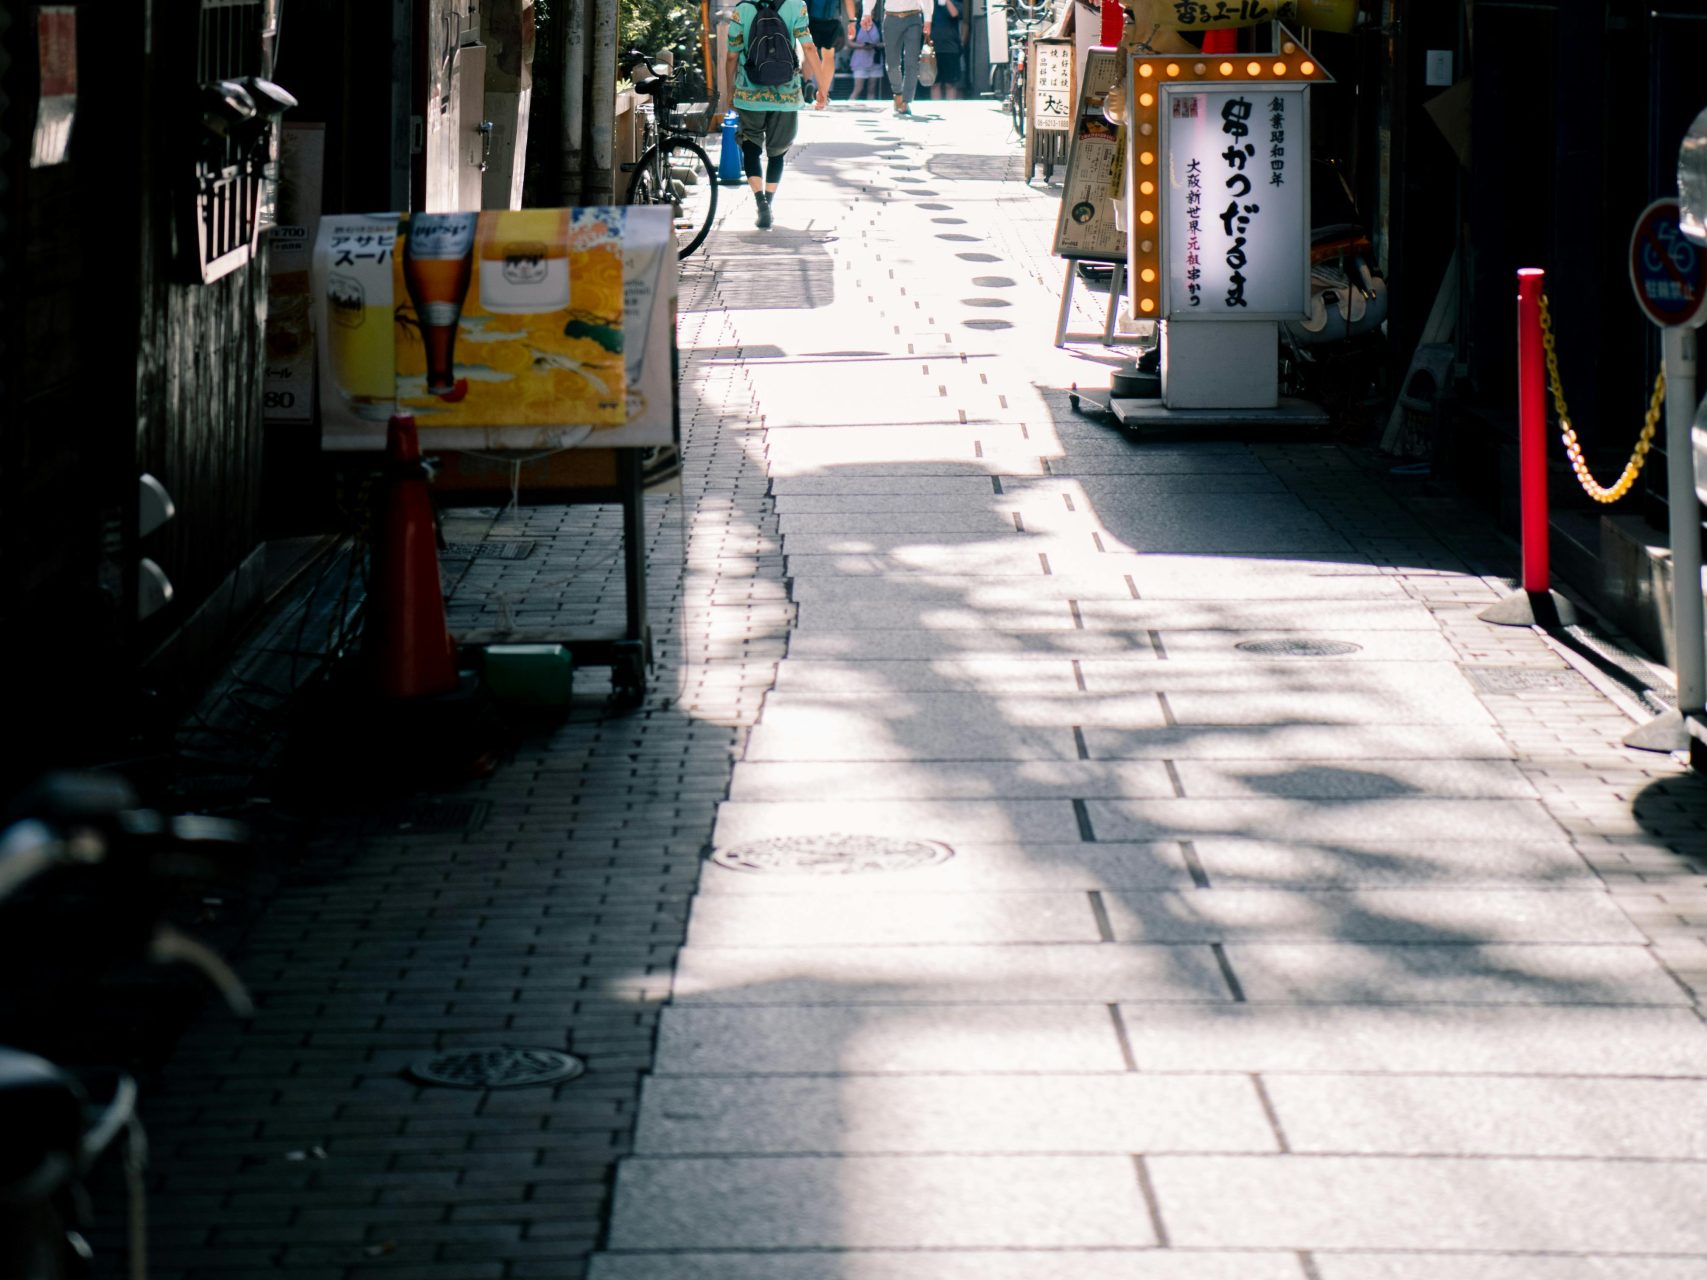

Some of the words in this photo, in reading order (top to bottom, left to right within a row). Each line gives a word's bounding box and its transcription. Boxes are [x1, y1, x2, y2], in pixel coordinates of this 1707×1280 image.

[1039, 51, 1048, 87] 一品料理
[1060, 49, 1069, 88] お好み焼
[1043, 95, 1069, 115] 大たこ
[1267, 96, 1285, 188] 創業昭和四年
[1186, 158, 1201, 307] 大阪新世界元祖串かつ
[1219, 96, 1260, 308] 串かつだるま
